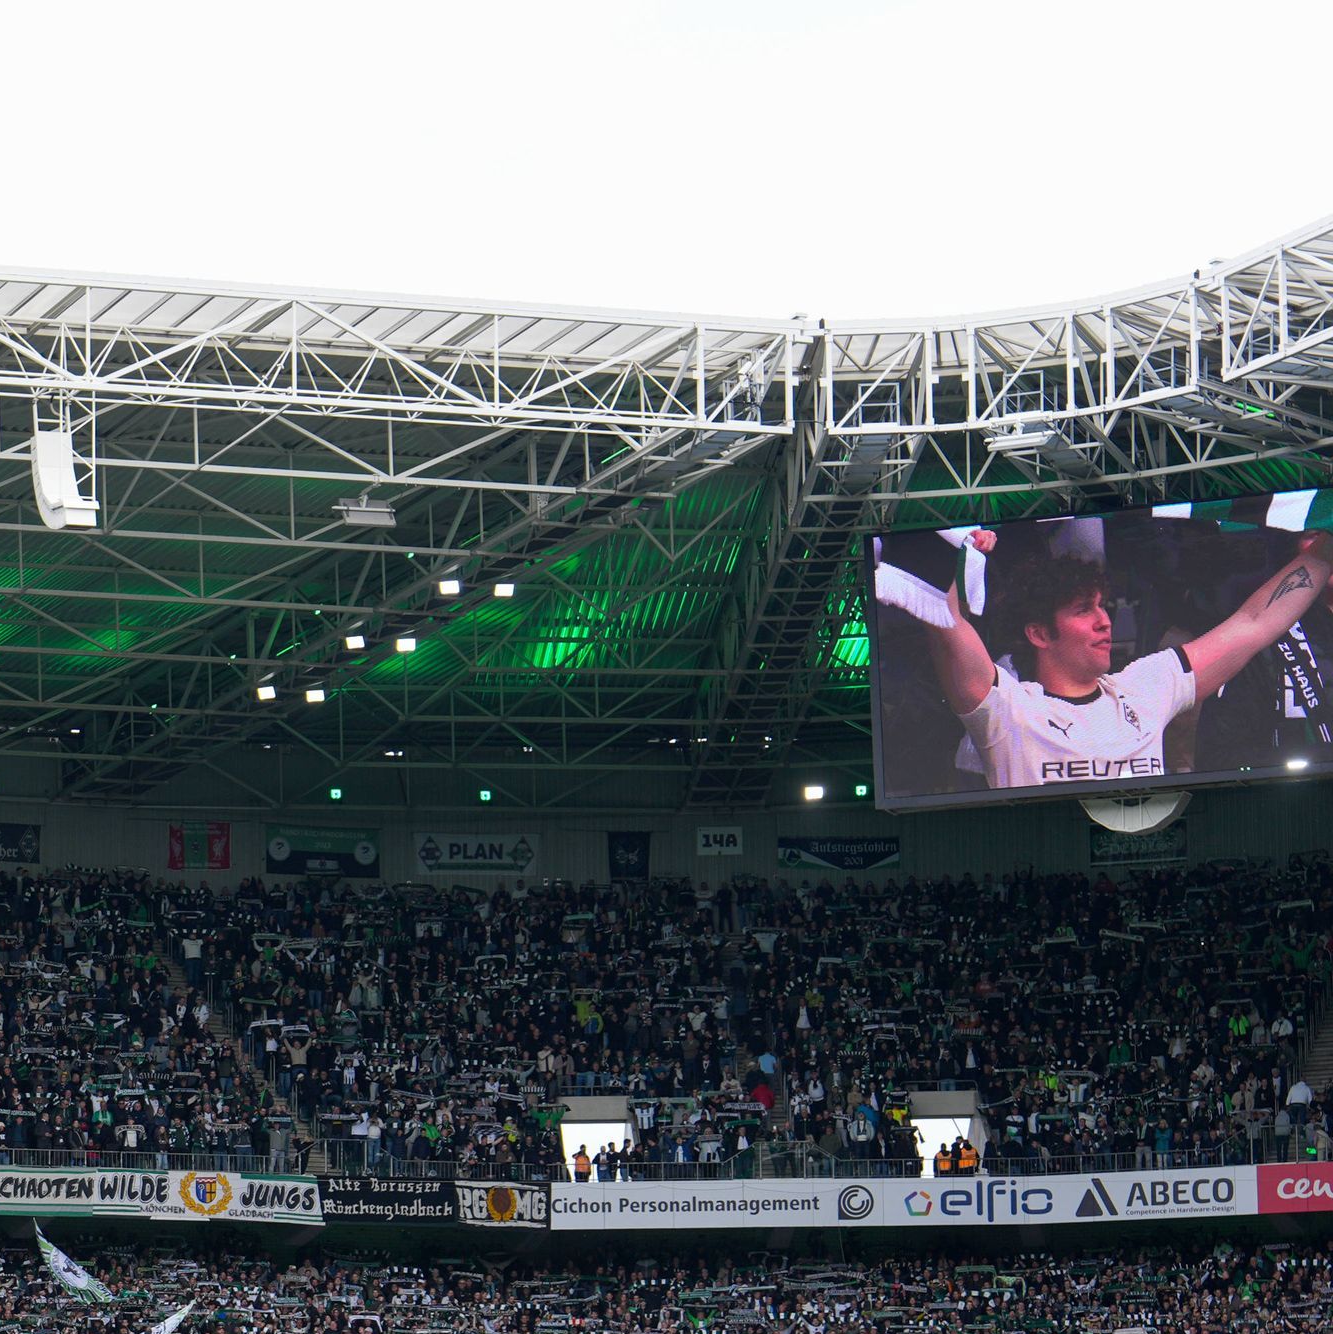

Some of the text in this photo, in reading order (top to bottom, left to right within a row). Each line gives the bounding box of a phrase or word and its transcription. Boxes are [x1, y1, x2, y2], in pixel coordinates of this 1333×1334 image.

[1278, 642, 1296, 662] ZU
[1292, 664, 1319, 709] HAUS
[1041, 757, 1162, 779] REUTER
[449, 843, 504, 859] PLAN
[702, 834, 739, 848] 14A
[99, 1174, 316, 1212] WILDE JUNGS
[328, 1177, 442, 1194] Alte Borussen
[1125, 1177, 1234, 1207] ABECO
[139, 1204, 274, 1219] MÖNCHEN GLADBACH
[322, 1198, 454, 1221] Mönchengladbach
[514, 1186, 547, 1220] MG
[551, 1195, 820, 1216] Cichon Personalmanagement
[1126, 1208, 1167, 1218] Competence
[1177, 1205, 1235, 1217] Hardware-Design
